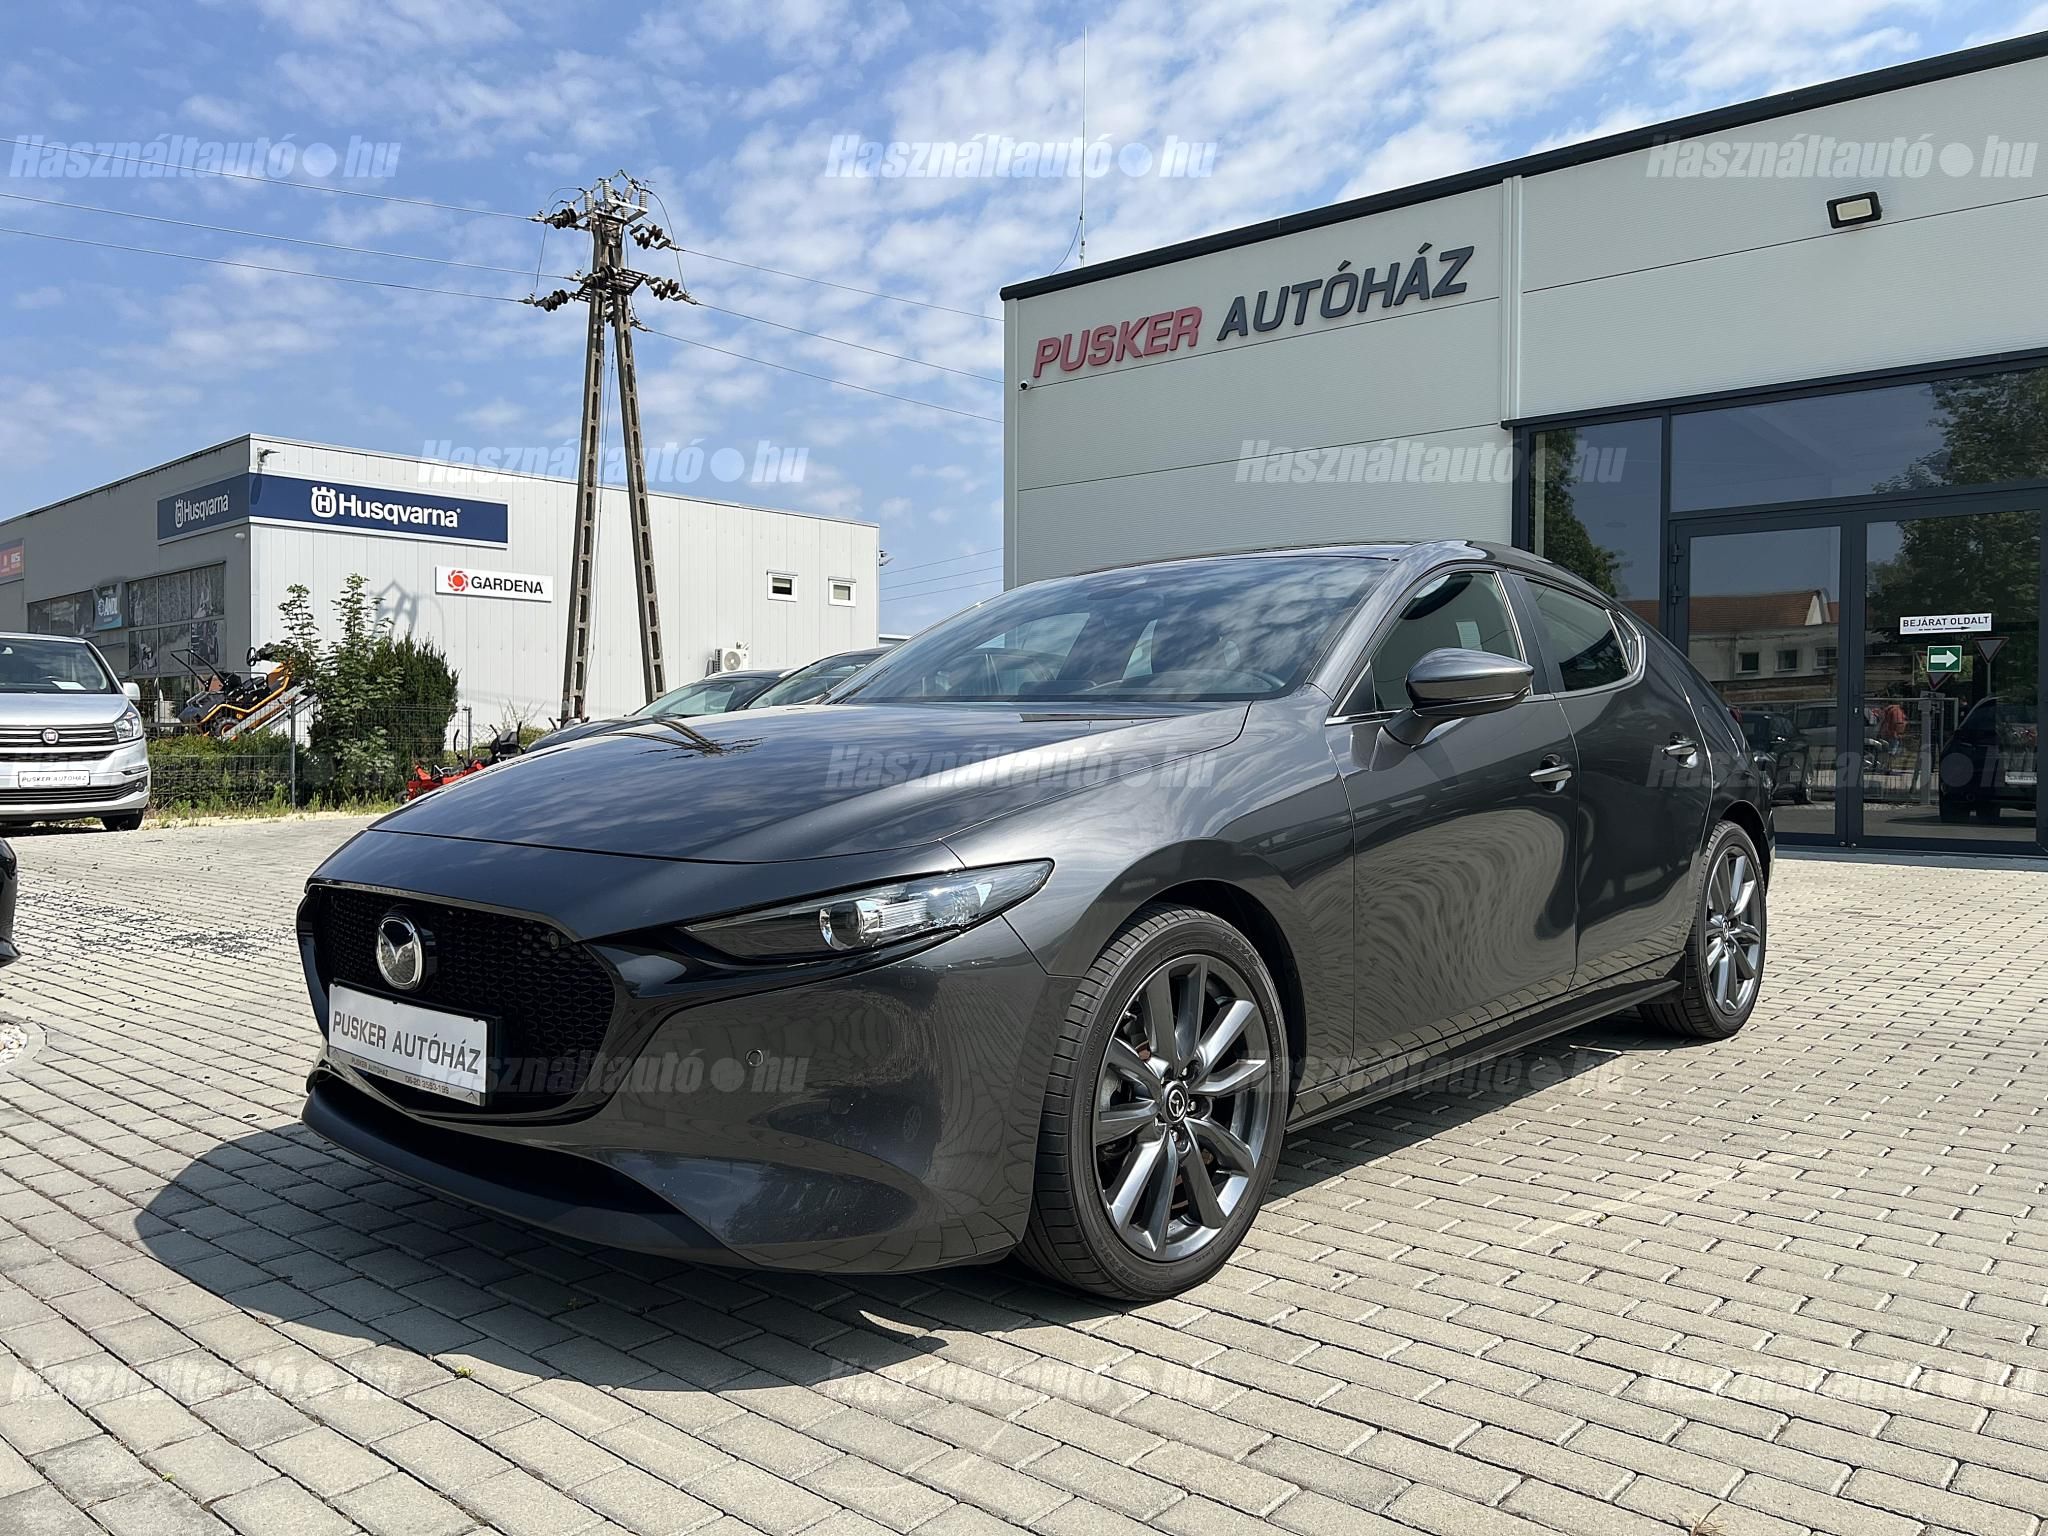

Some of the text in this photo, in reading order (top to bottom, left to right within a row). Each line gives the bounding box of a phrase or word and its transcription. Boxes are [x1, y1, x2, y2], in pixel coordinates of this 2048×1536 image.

[1033, 242, 1475, 380] PUSKER AUTÓHÁZ
[183, 493, 229, 523] Husqvarna
[339, 493, 460, 529] Husqvarna
[471, 575, 544, 596] GARDENA
[1902, 614, 1990, 628] BEJÁRAT OLDALT
[332, 1011, 482, 1074] PUSKER AUTÓHÁZ
